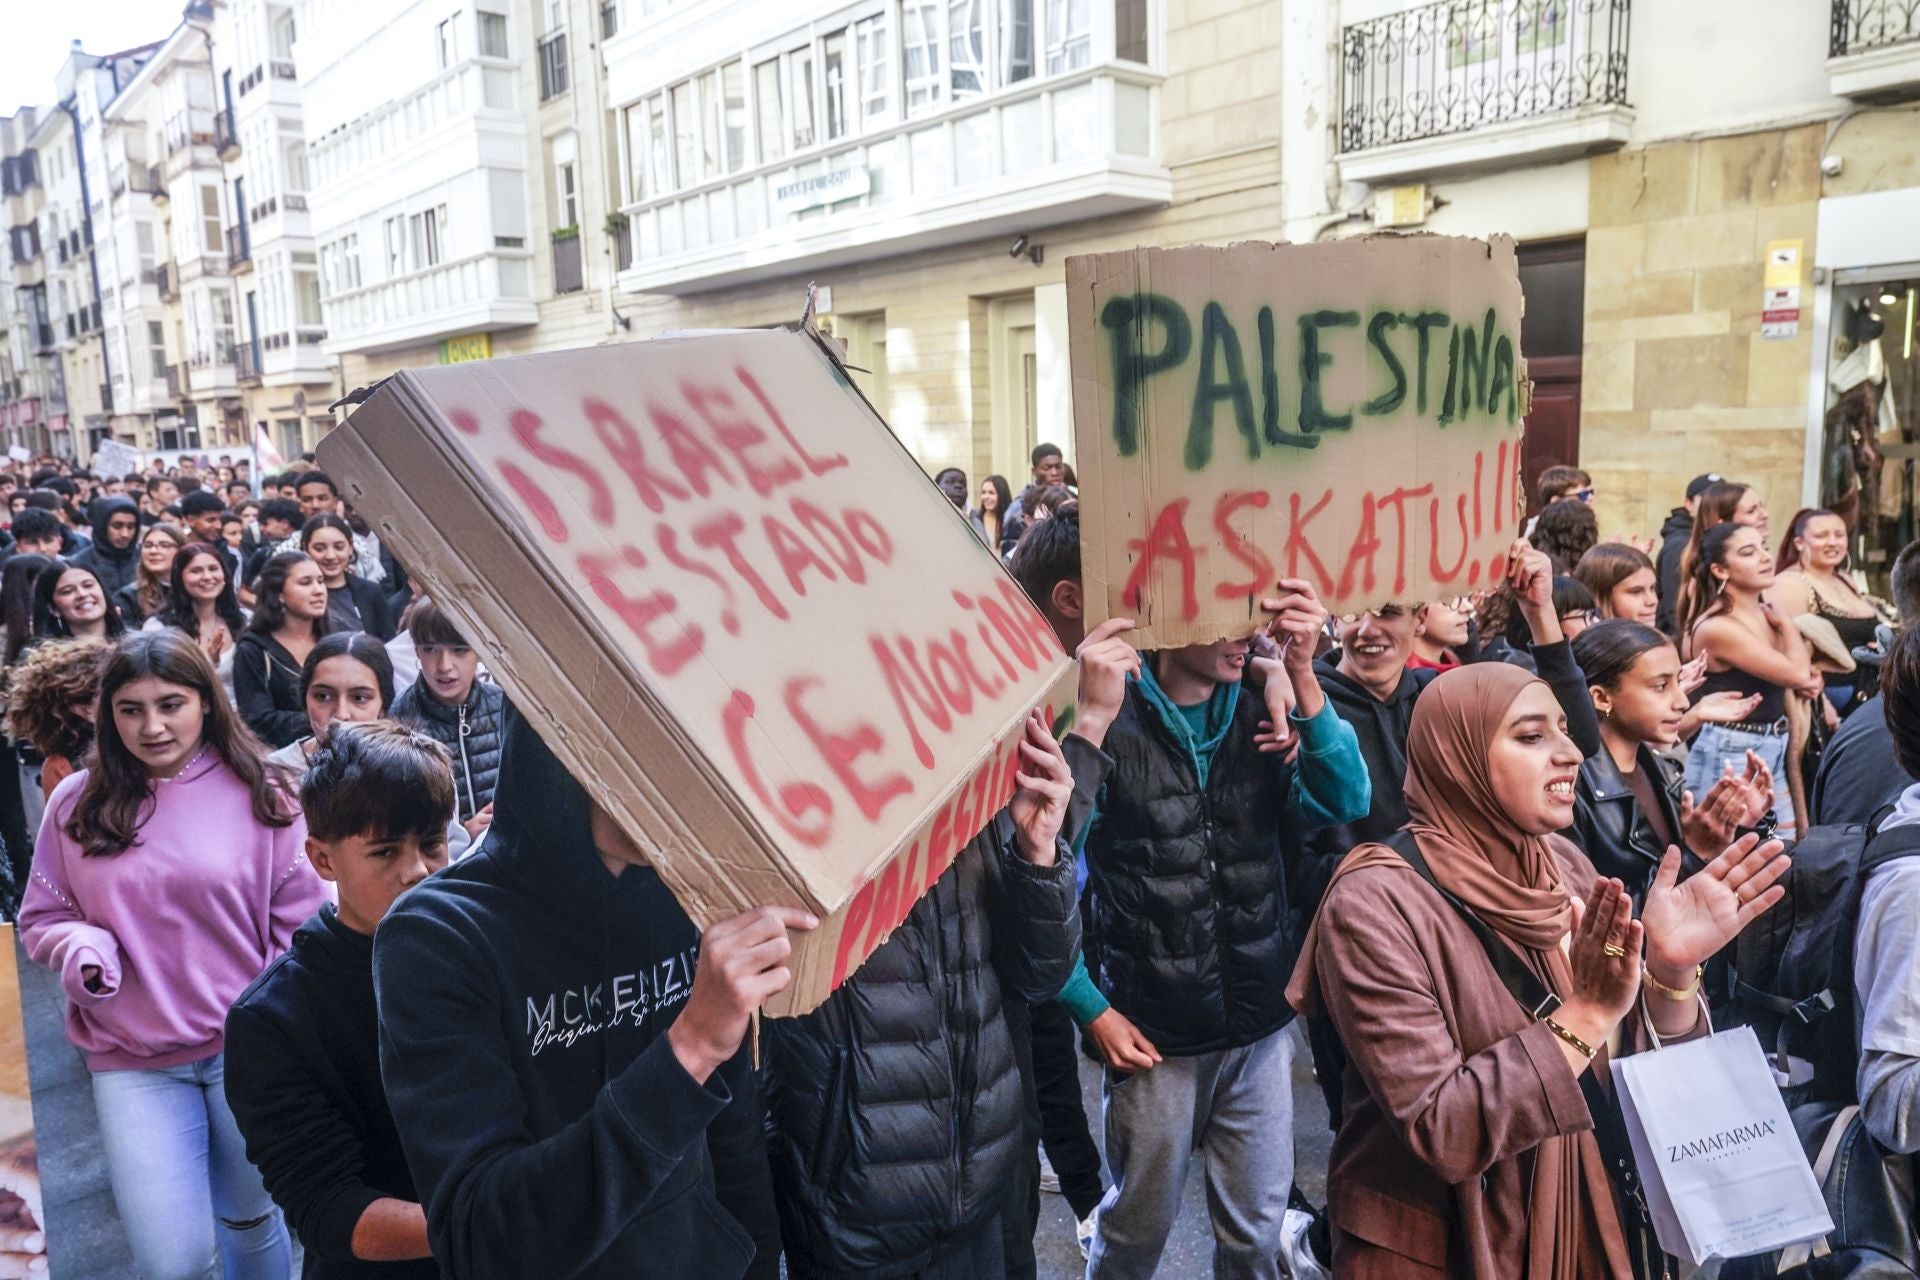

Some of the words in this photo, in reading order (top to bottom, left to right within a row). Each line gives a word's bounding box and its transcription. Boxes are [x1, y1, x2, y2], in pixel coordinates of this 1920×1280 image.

[1101, 292, 1515, 471] PALESTINA
[577, 498, 893, 677] ESTADO
[532, 1002, 623, 1056] Originl
[1667, 1121, 1775, 1163] ZAMAFARMA
